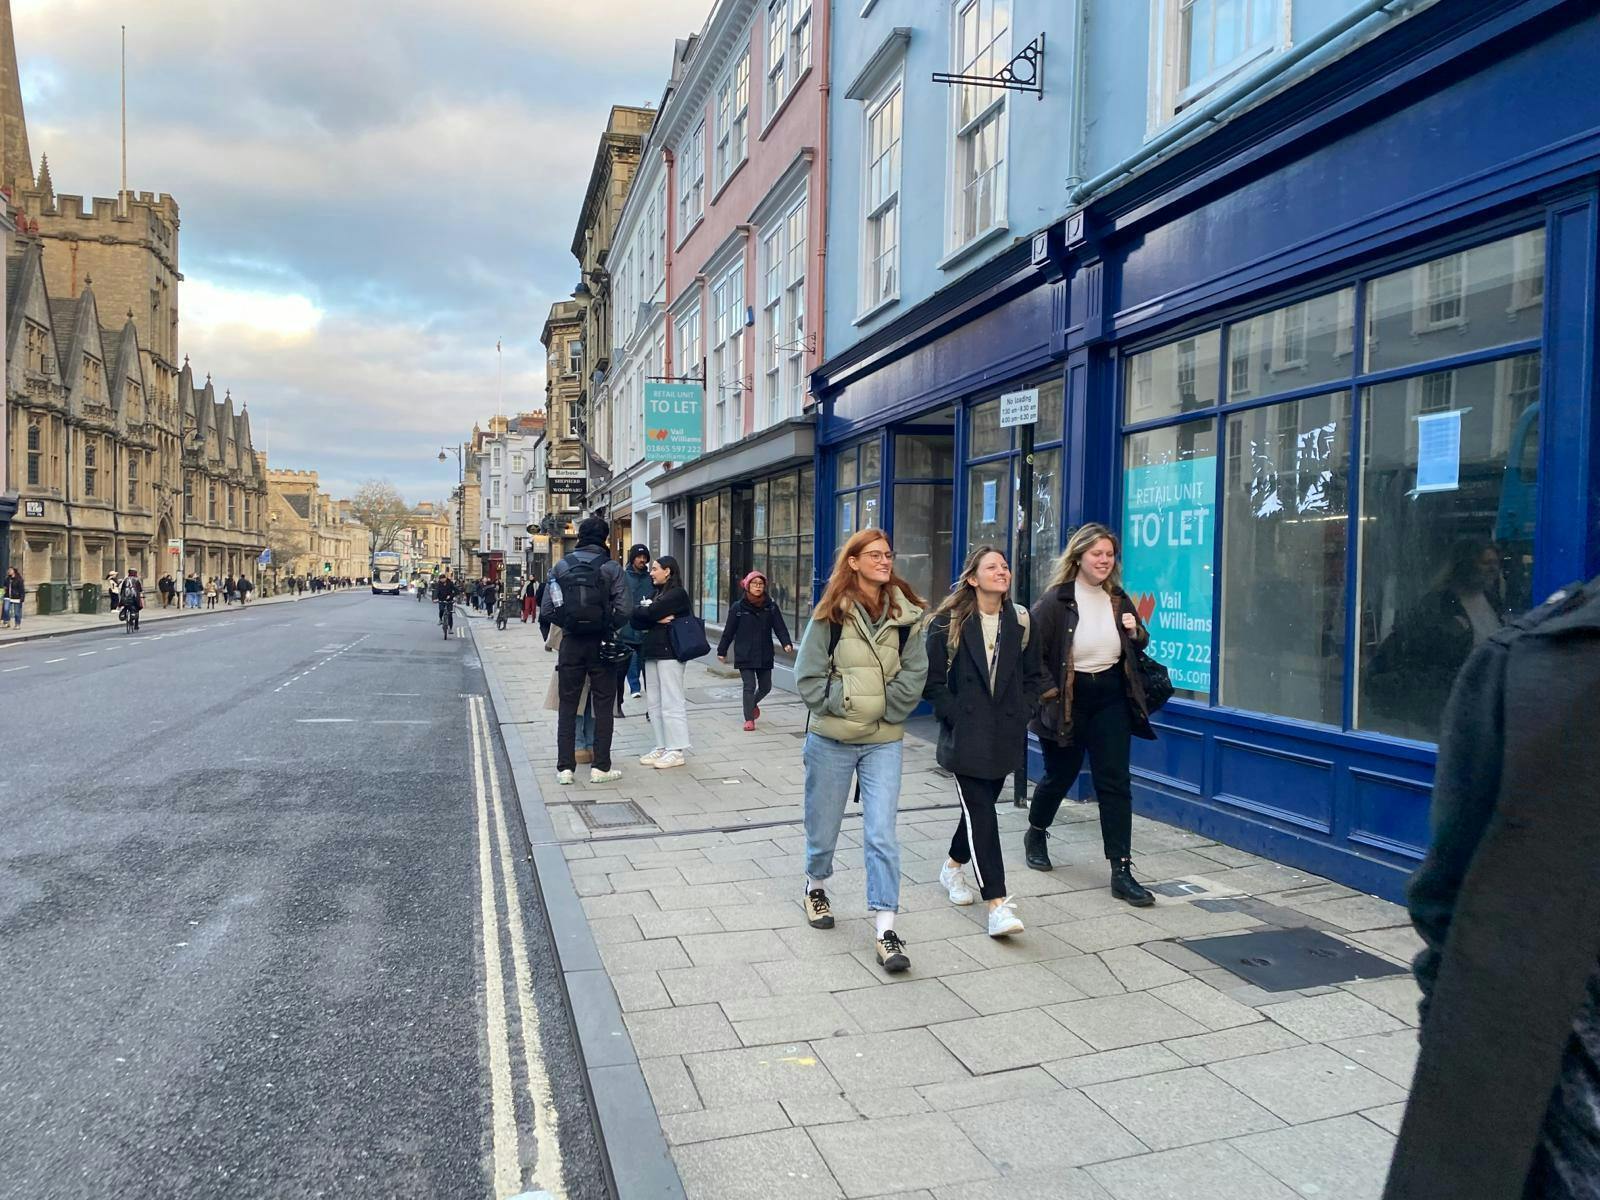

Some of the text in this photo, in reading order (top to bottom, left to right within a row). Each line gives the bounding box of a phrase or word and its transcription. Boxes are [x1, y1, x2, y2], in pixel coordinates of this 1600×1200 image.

[650, 400, 698, 414] TO LET
[1015, 396, 1032, 404] loading
[1136, 481, 1204, 505] RETAIL UNIT
[1130, 507, 1210, 548] TO LET
[1159, 591, 1182, 609] Vail
[1159, 611, 1212, 633] Williams
[1160, 640, 1184, 660] 597
[1186, 643, 1211, 664] 222
